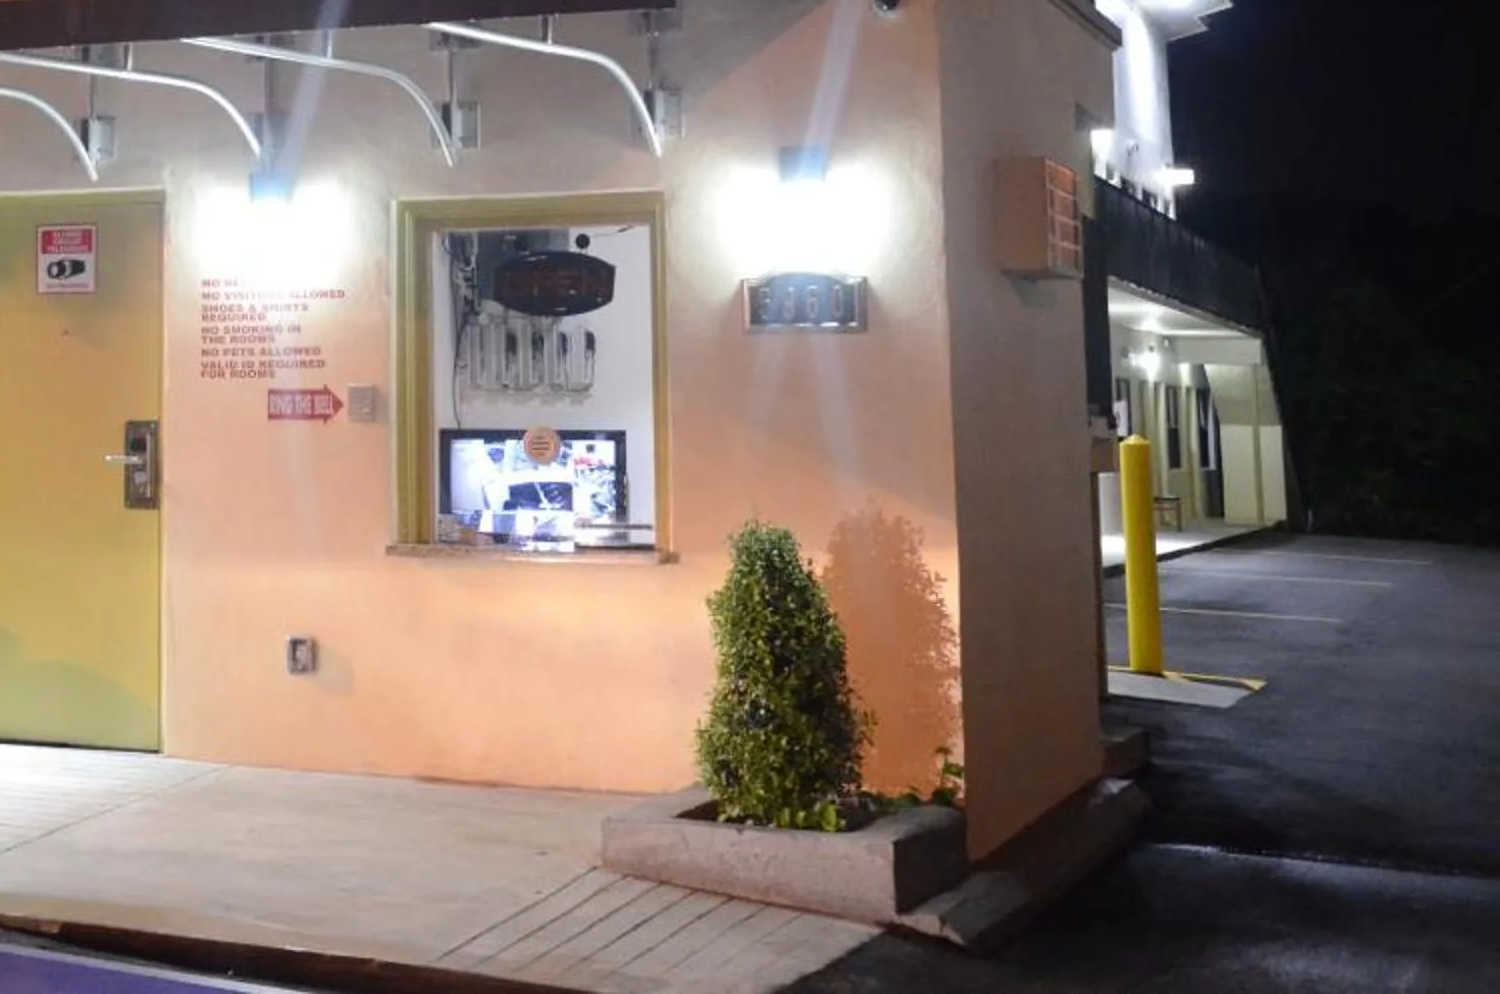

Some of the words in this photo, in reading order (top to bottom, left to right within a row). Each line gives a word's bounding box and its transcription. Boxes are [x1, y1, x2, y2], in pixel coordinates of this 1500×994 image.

[201, 291, 220, 300] NO
[201, 326, 219, 335] NO
[223, 325, 282, 334] SMOKING
[201, 335, 225, 344] THE
[229, 335, 275, 344] ROOMS
[201, 348, 219, 357] NO
[223, 347, 257, 356] PETS
[260, 347, 321, 356] ALLOWED
[201, 360, 238, 369] VALID
[241, 360, 255, 369] ID
[259, 359, 326, 369] REQUIRED
[201, 370, 226, 379] FOR
[229, 370, 275, 379] ROOMS
